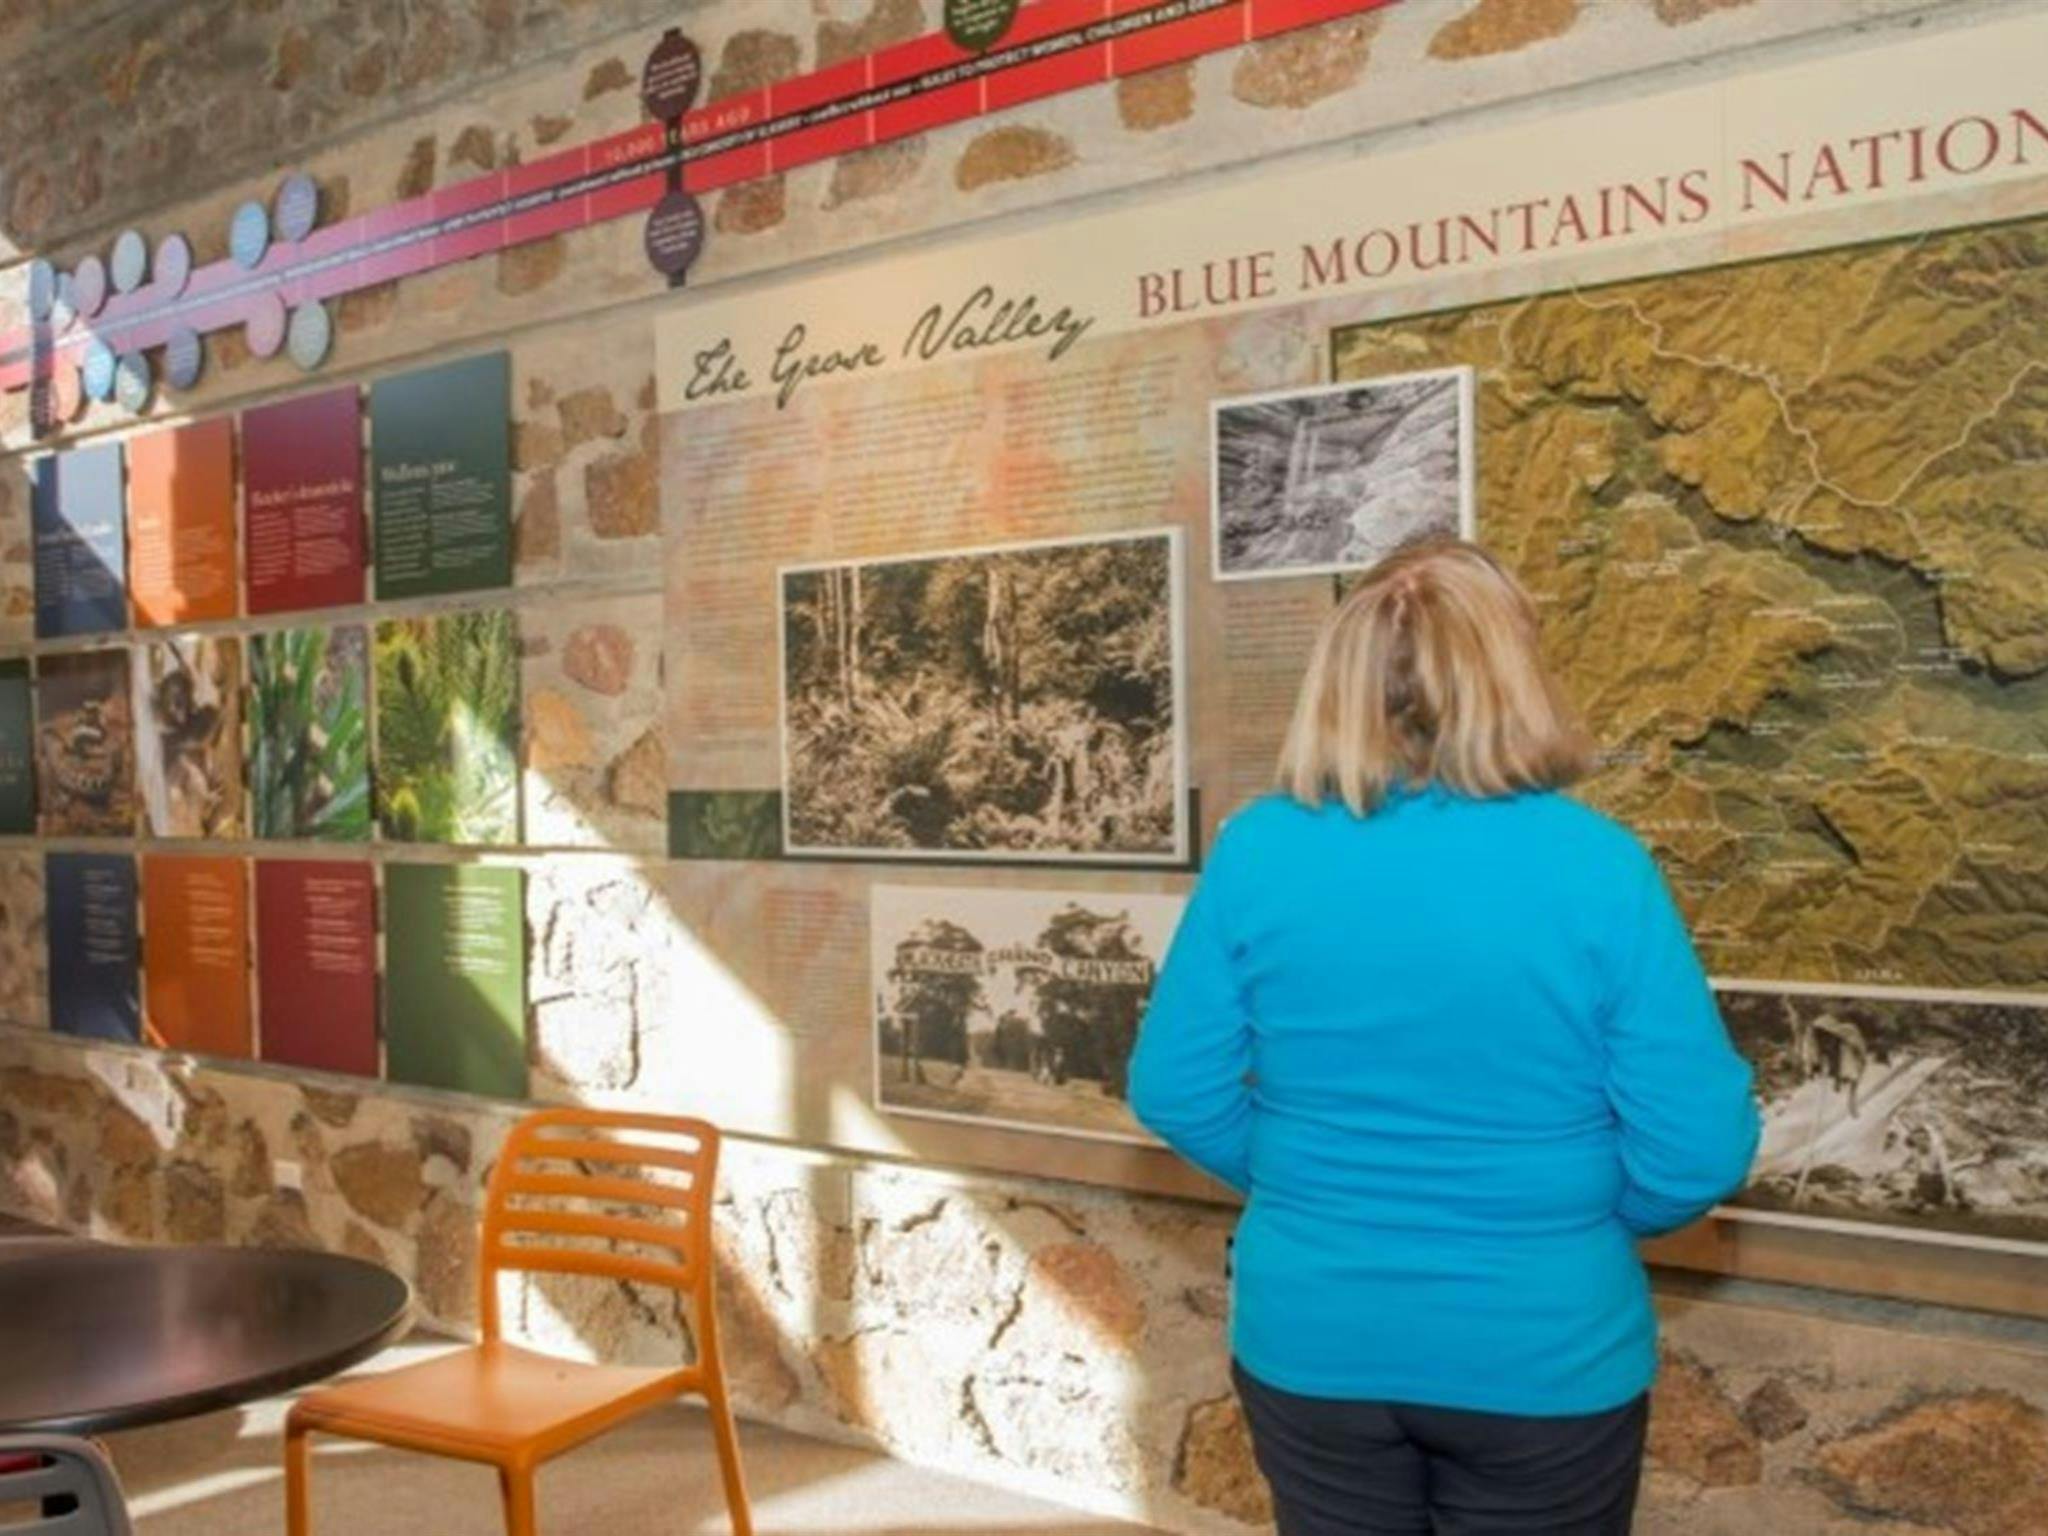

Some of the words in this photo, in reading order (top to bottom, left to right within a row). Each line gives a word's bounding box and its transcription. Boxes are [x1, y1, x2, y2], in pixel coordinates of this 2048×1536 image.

[1138, 251, 1276, 318] BLUE
[1300, 170, 1710, 290] MOUNTAINS
[685, 338, 749, 400] The
[903, 284, 1096, 361] Valley
